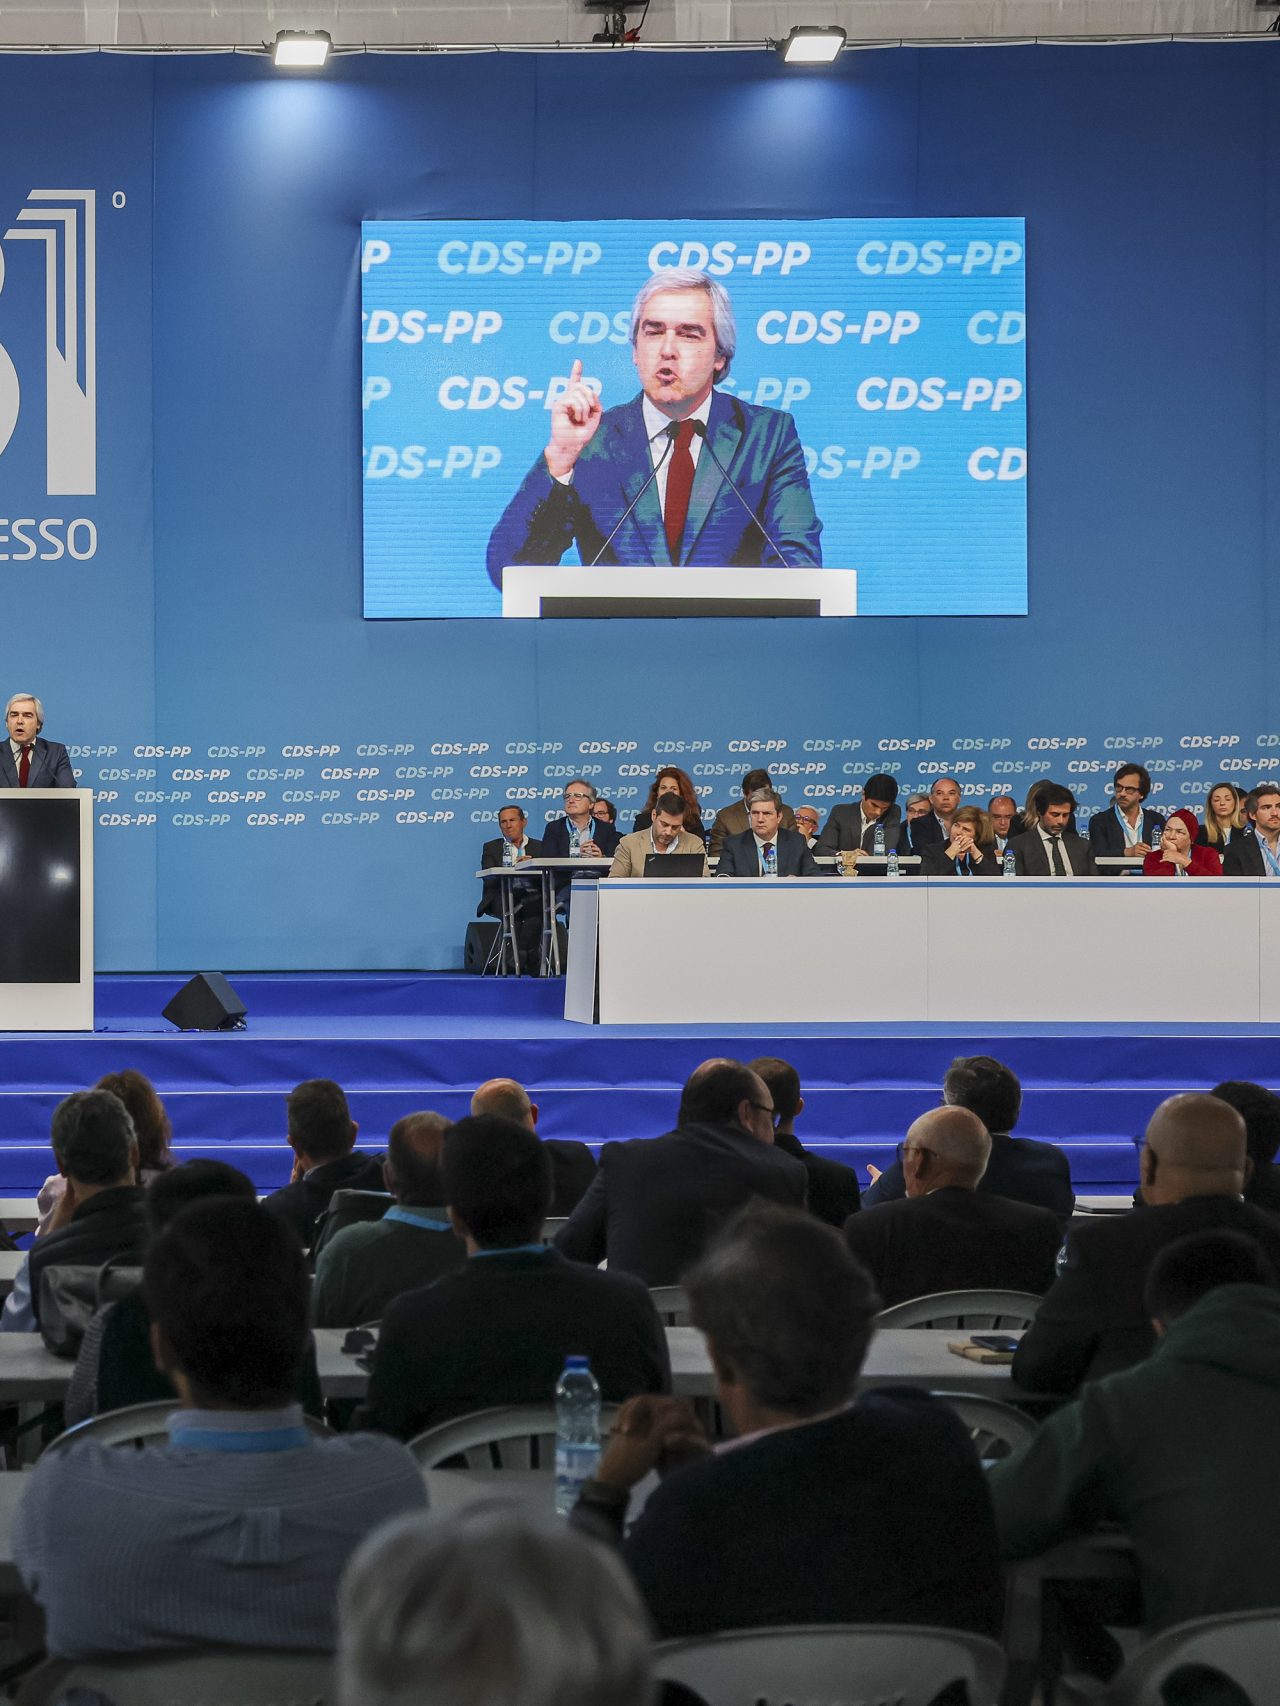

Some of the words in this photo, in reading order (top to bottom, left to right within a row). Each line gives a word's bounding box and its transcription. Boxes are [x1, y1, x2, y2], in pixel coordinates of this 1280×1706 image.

[437, 240, 602, 275] CDS-PP
[648, 241, 811, 275] CDS-PP
[856, 241, 1023, 275] CDS-PP
[363, 310, 503, 344] DS-PP
[756, 310, 920, 345] CDS-PP
[856, 377, 1023, 411] CDS-PP
[363, 446, 501, 479] DS-PP
[133, 745, 192, 757] CDS-PP
[207, 745, 266, 757] CDS-PP
[282, 745, 341, 757] CDS-PP
[356, 744, 415, 756] CDS-PP
[430, 743, 490, 755] CDS-PP
[505, 742, 563, 754] CDS-PP
[579, 741, 638, 753] CDS-PP
[653, 741, 713, 753] CDS-PP
[728, 740, 787, 752] CDS-PP
[803, 739, 862, 751] CDS-PP
[877, 739, 936, 751] CDS-PP
[952, 738, 1012, 750] CDS-PP
[1027, 737, 1088, 749] CDS-PP
[1103, 737, 1164, 749] CDS-PP
[1180, 735, 1240, 747] CDS-PP
[98, 768, 157, 780] CDS-PP
[172, 768, 231, 780] CDS-PP
[246, 768, 305, 780] CDS-PP
[321, 767, 380, 779] CDS-PP
[395, 766, 454, 778] CDS-PP
[469, 766, 529, 778] CDS-PP
[543, 765, 603, 777] CDS-PP
[692, 764, 752, 776] CDS-PP
[767, 763, 827, 775] CDS-PP
[842, 762, 902, 774] CDS-PP
[917, 762, 976, 774] CDS-PP
[992, 761, 1051, 773] CDS-PP
[1144, 759, 1204, 771] CDS-PP
[1219, 758, 1280, 770] CDS-PP
[134, 790, 192, 802] CDS-PP
[207, 790, 267, 802] CDS-PP
[282, 790, 341, 802] CDS-PP
[356, 789, 416, 801] CDS-PP
[430, 788, 490, 800] CDS-PP
[505, 787, 563, 799] CDS-PP
[803, 785, 862, 797] CDS-PP
[99, 813, 157, 825] CDS-PP
[172, 813, 231, 825] CDS-PP
[246, 812, 306, 824] CDS-PP
[321, 812, 380, 824] CDS-PP
[395, 811, 455, 823] CDS-PP
